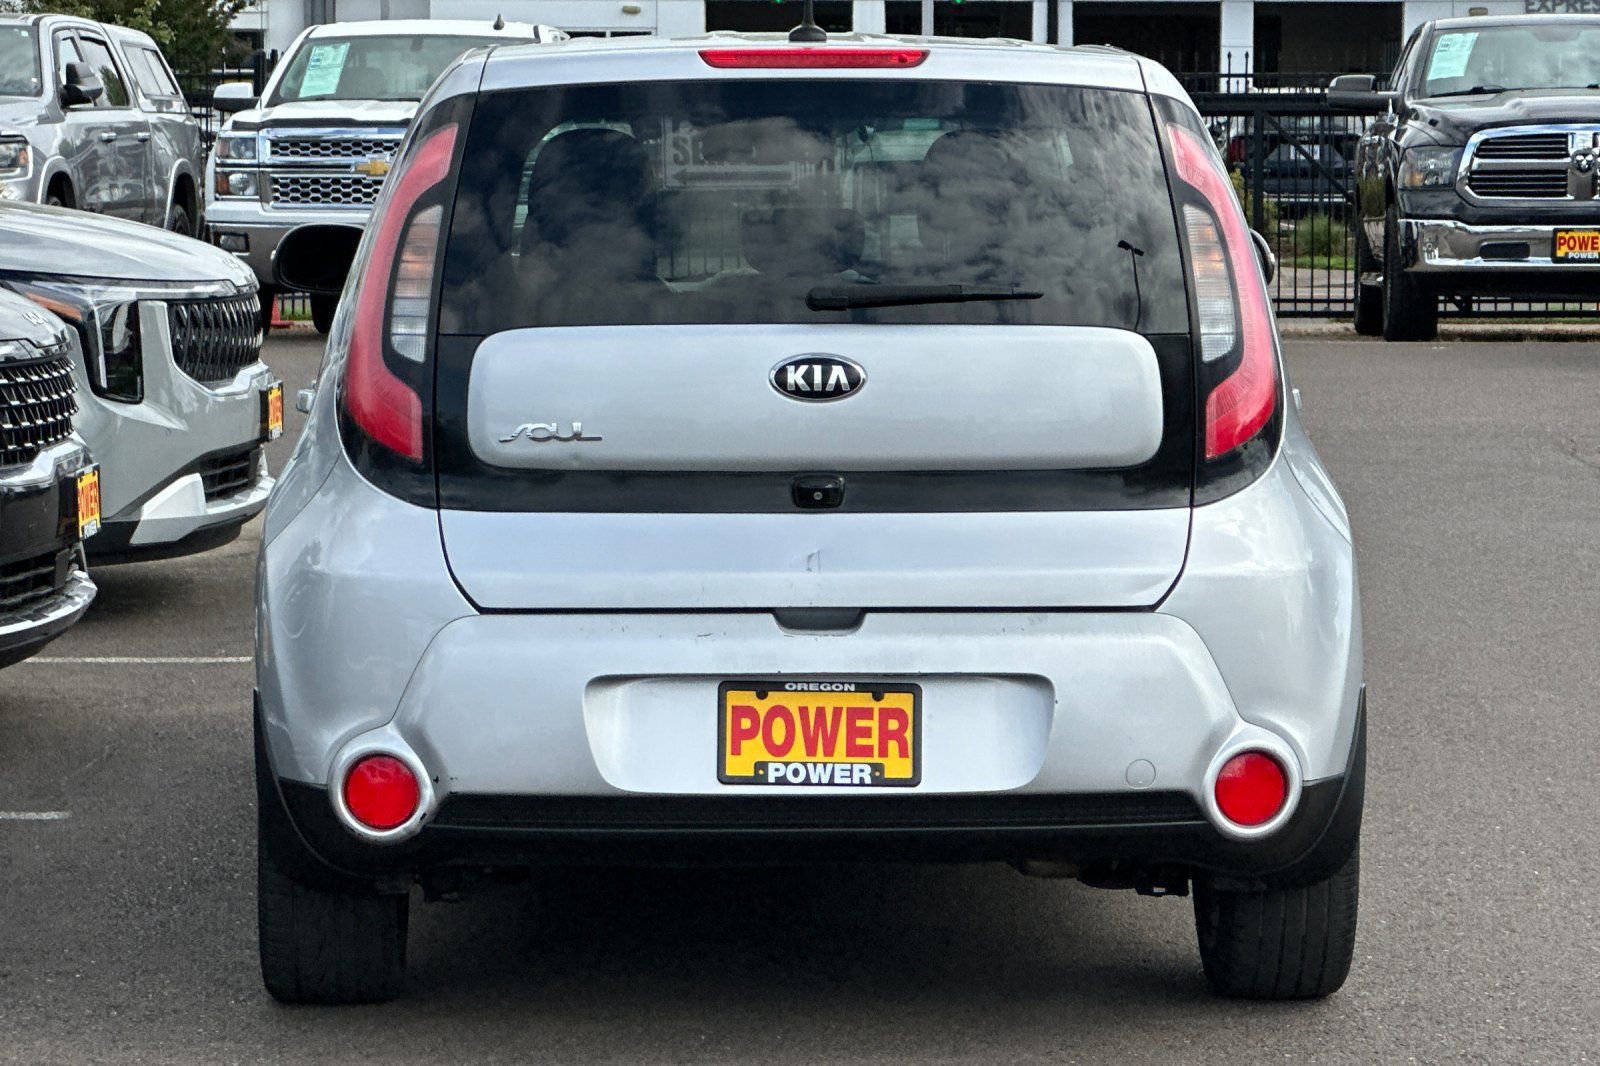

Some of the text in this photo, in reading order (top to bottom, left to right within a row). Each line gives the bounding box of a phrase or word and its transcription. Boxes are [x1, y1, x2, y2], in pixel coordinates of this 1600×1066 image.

[786, 365, 850, 392] KIA
[499, 422, 602, 443] SOUL
[784, 682, 857, 692] OREGON
[730, 704, 910, 758] POWER
[767, 762, 872, 784] POWER
